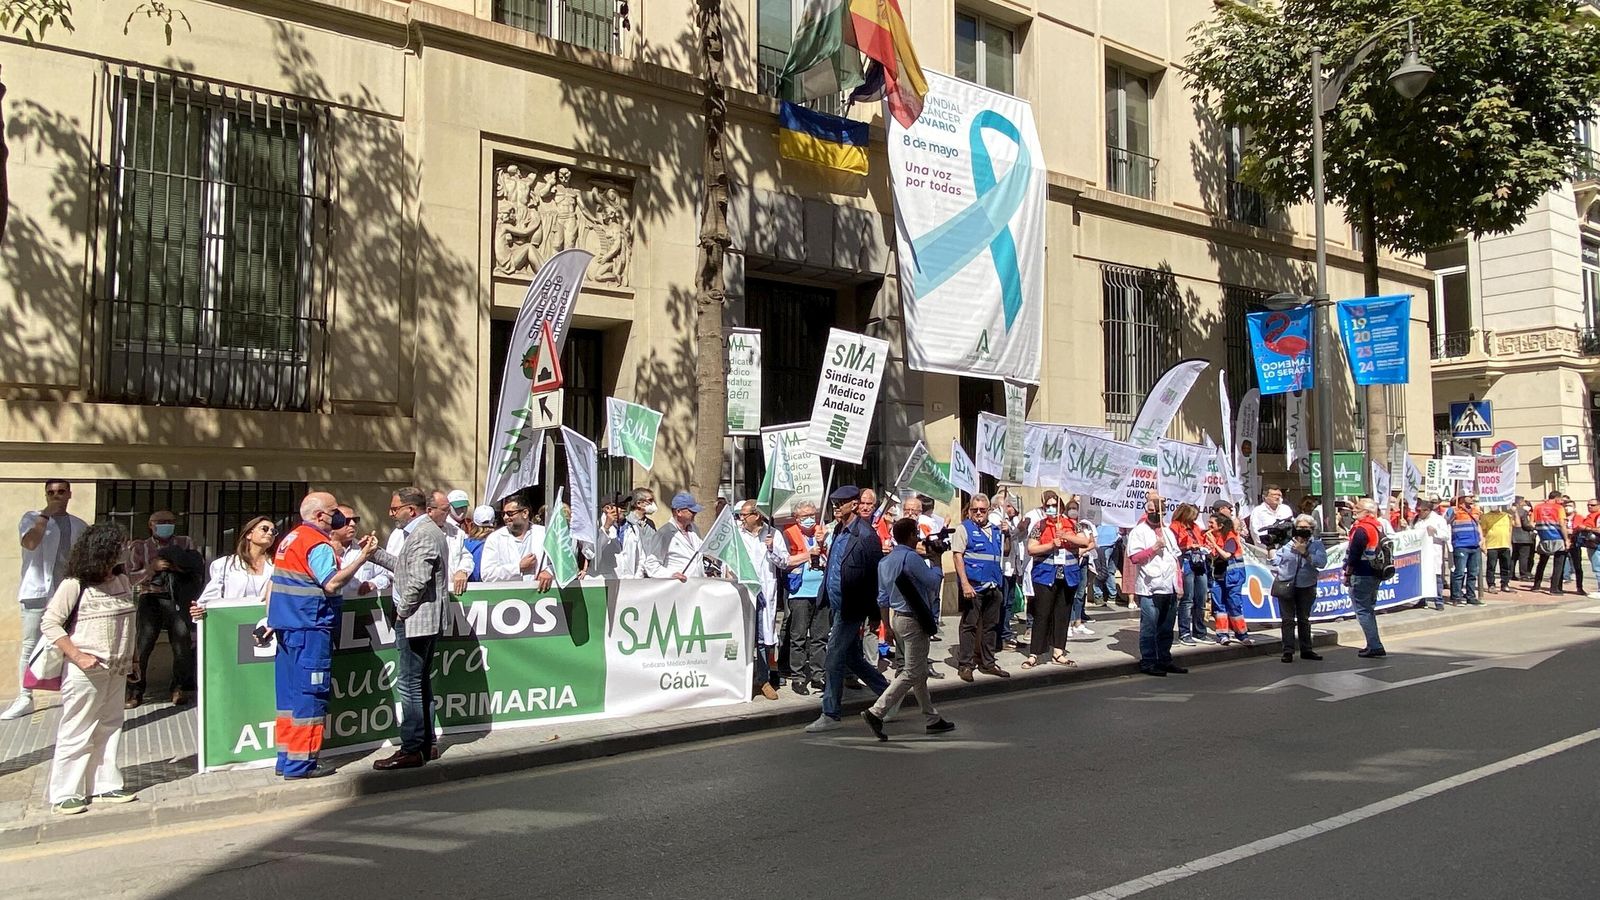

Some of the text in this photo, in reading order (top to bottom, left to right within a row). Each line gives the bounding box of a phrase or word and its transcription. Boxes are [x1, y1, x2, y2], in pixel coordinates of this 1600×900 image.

[925, 95, 963, 115] UNDIAL
[918, 115, 957, 133] OVARIO
[903, 134, 959, 158] 8 de mayo
[905, 161, 952, 181] Una voz
[906, 176, 962, 196] por todas
[552, 275, 564, 295] de
[528, 279, 552, 340] Sindicato
[1351, 318, 1367, 331] 19
[724, 336, 752, 351] MA
[1353, 331, 1370, 343] 20
[725, 357, 753, 366] ndicato
[832, 342, 876, 374] SMA
[1358, 361, 1375, 373] 24
[727, 367, 750, 376] édico
[824, 368, 875, 389] Sindicato
[1264, 371, 1275, 379] LO
[726, 377, 752, 386] ndaluz
[828, 384, 866, 402] Médico
[822, 397, 865, 416] Andaluz
[621, 418, 652, 444] SMA
[984, 423, 1006, 461] SM
[1561, 436, 1577, 453] P
[786, 451, 811, 461] dicato
[1068, 442, 1119, 479] SMA
[789, 462, 808, 471] dico
[1132, 469, 1151, 478] IVOS
[1312, 462, 1357, 479] SA
[794, 472, 811, 481] aluz
[796, 482, 810, 494] én
[1203, 485, 1221, 495] TIVO
[254, 598, 558, 657] SLVMOS
[617, 600, 732, 658] SMA
[330, 645, 490, 699] nuera
[642, 658, 708, 669] Sindicato Médico Andaluz
[659, 670, 709, 691] Cádiz
[233, 697, 403, 755] ATCIÓ
